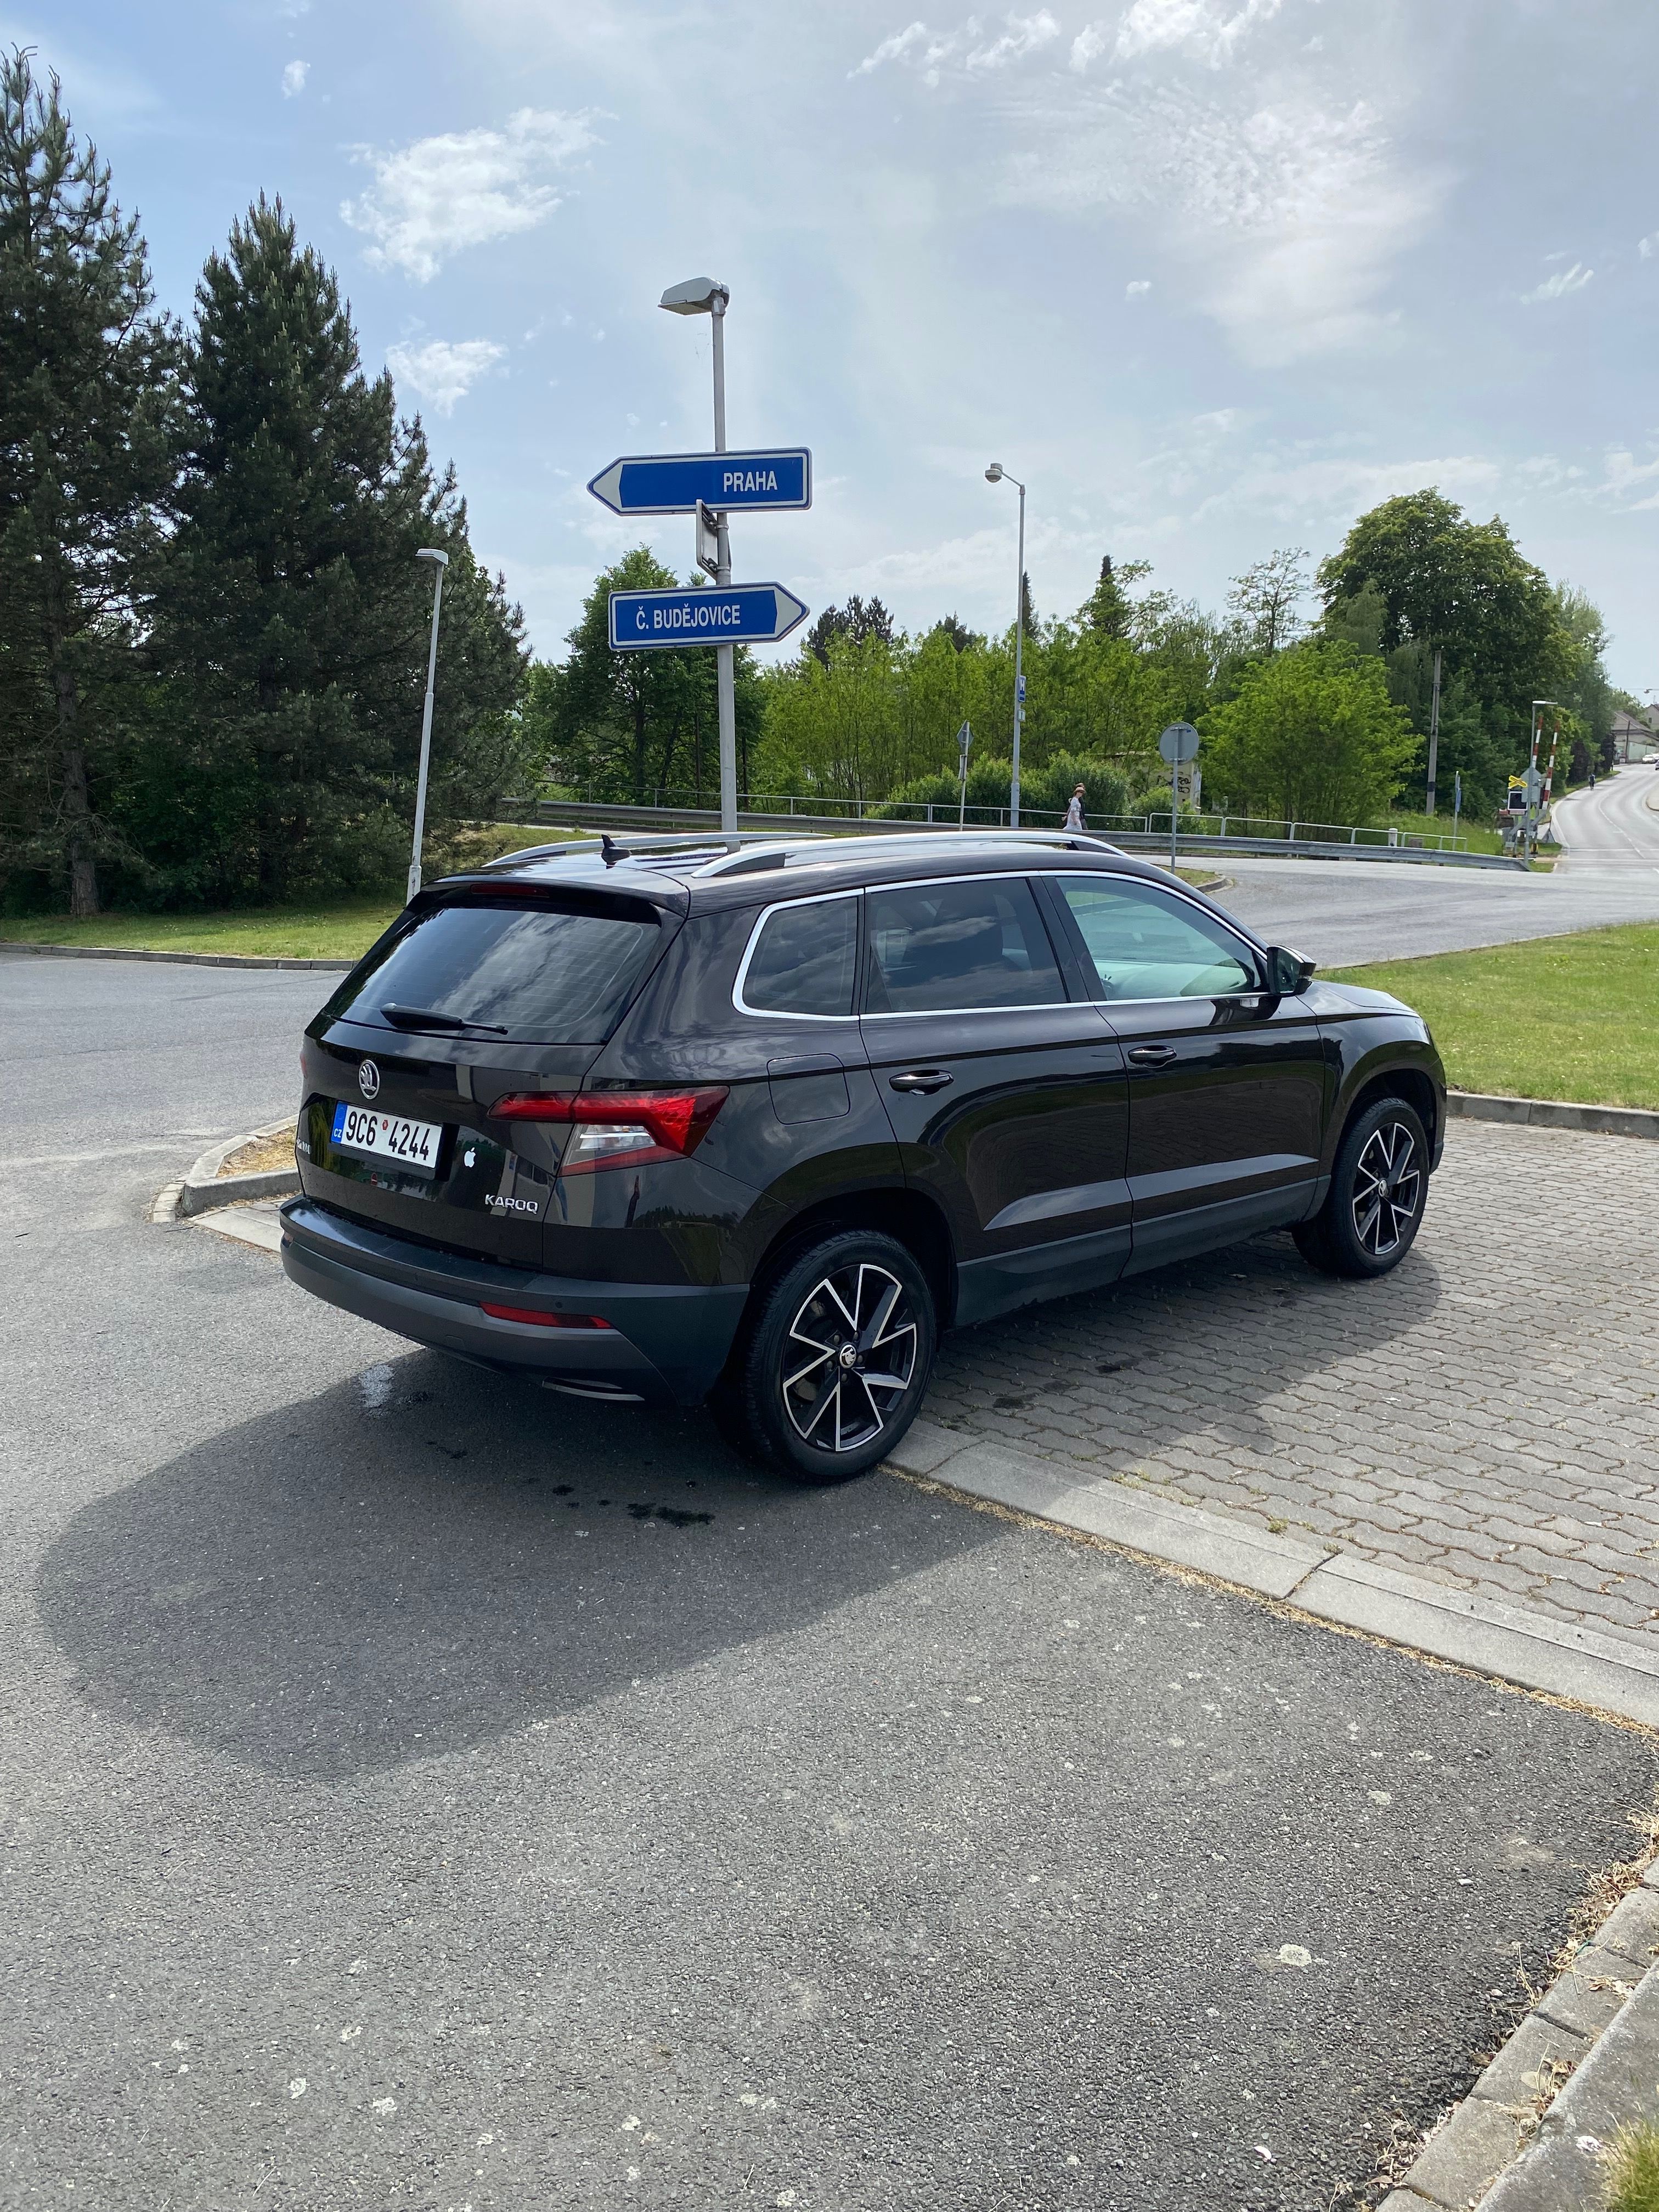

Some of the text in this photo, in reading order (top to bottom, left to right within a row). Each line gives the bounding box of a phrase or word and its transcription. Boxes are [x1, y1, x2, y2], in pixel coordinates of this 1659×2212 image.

[724, 471, 778, 492] PRAHA
[636, 603, 741, 630] Č. BUDĚJOVICE
[334, 1128, 342, 1138] CZ
[346, 1111, 378, 1146] 9C6
[388, 1121, 430, 1160] 4244
[485, 1194, 538, 1215] KAROQ
